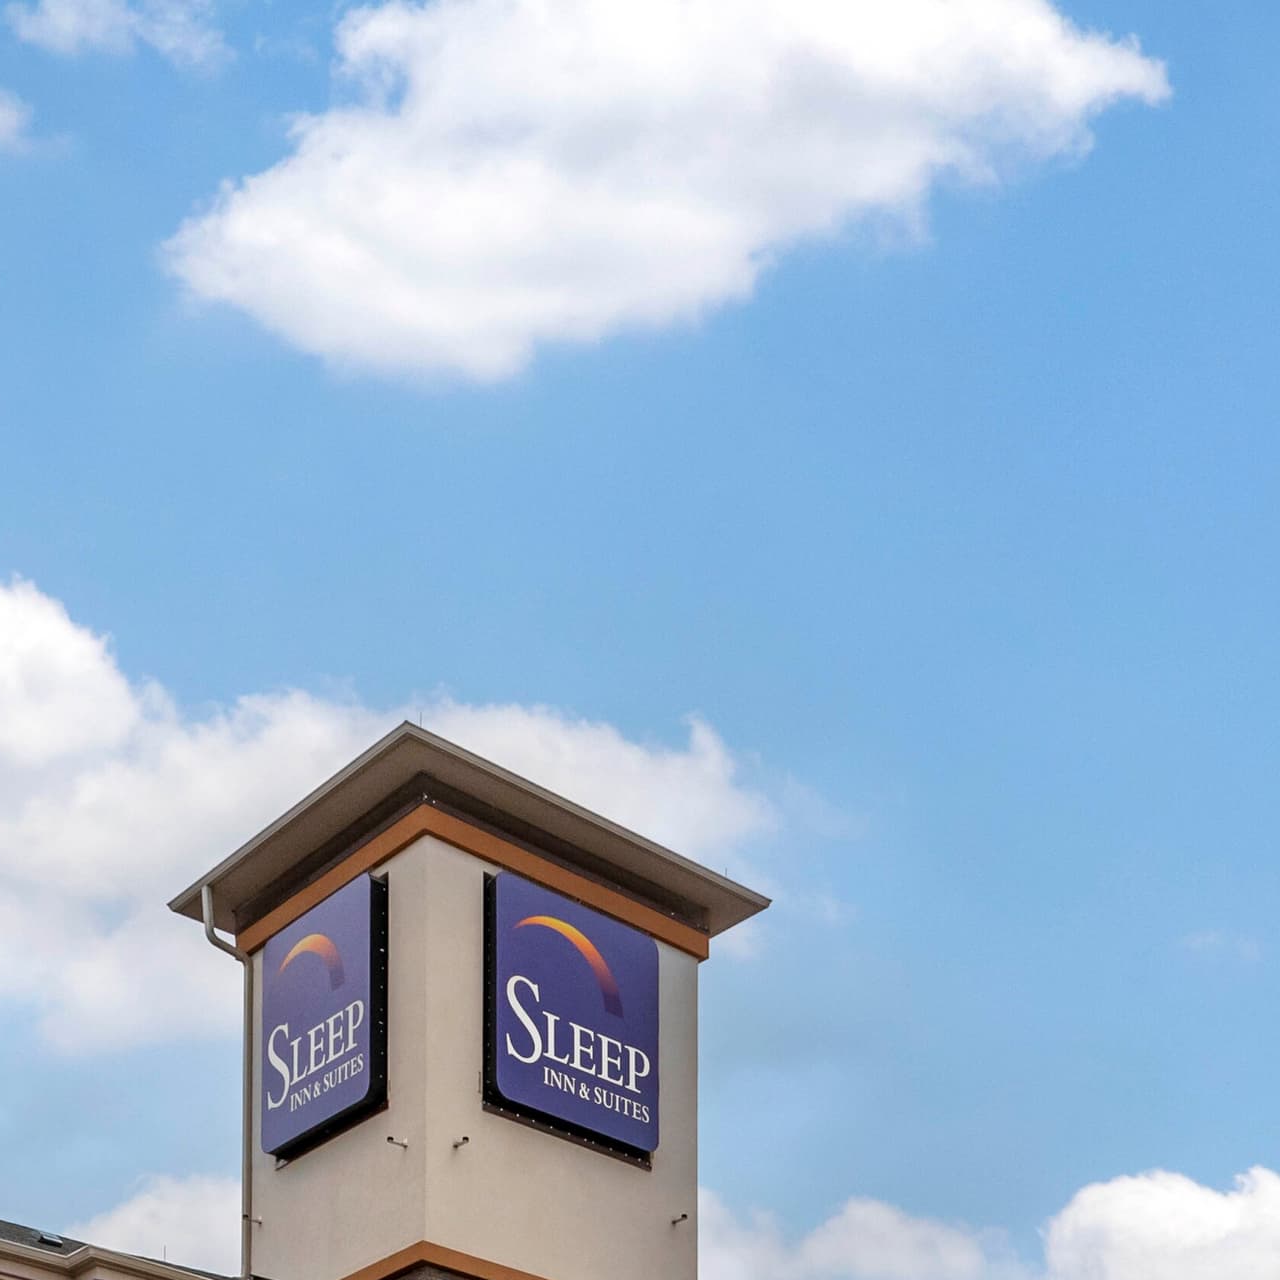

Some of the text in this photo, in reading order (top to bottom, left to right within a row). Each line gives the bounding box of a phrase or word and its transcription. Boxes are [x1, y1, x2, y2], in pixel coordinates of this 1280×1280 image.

[267, 1000, 364, 1110] SLEEP
[506, 975, 651, 1094] SLEEP
[290, 1053, 364, 1112] INN & SUITES
[543, 1066, 650, 1124] INN & SUITES
